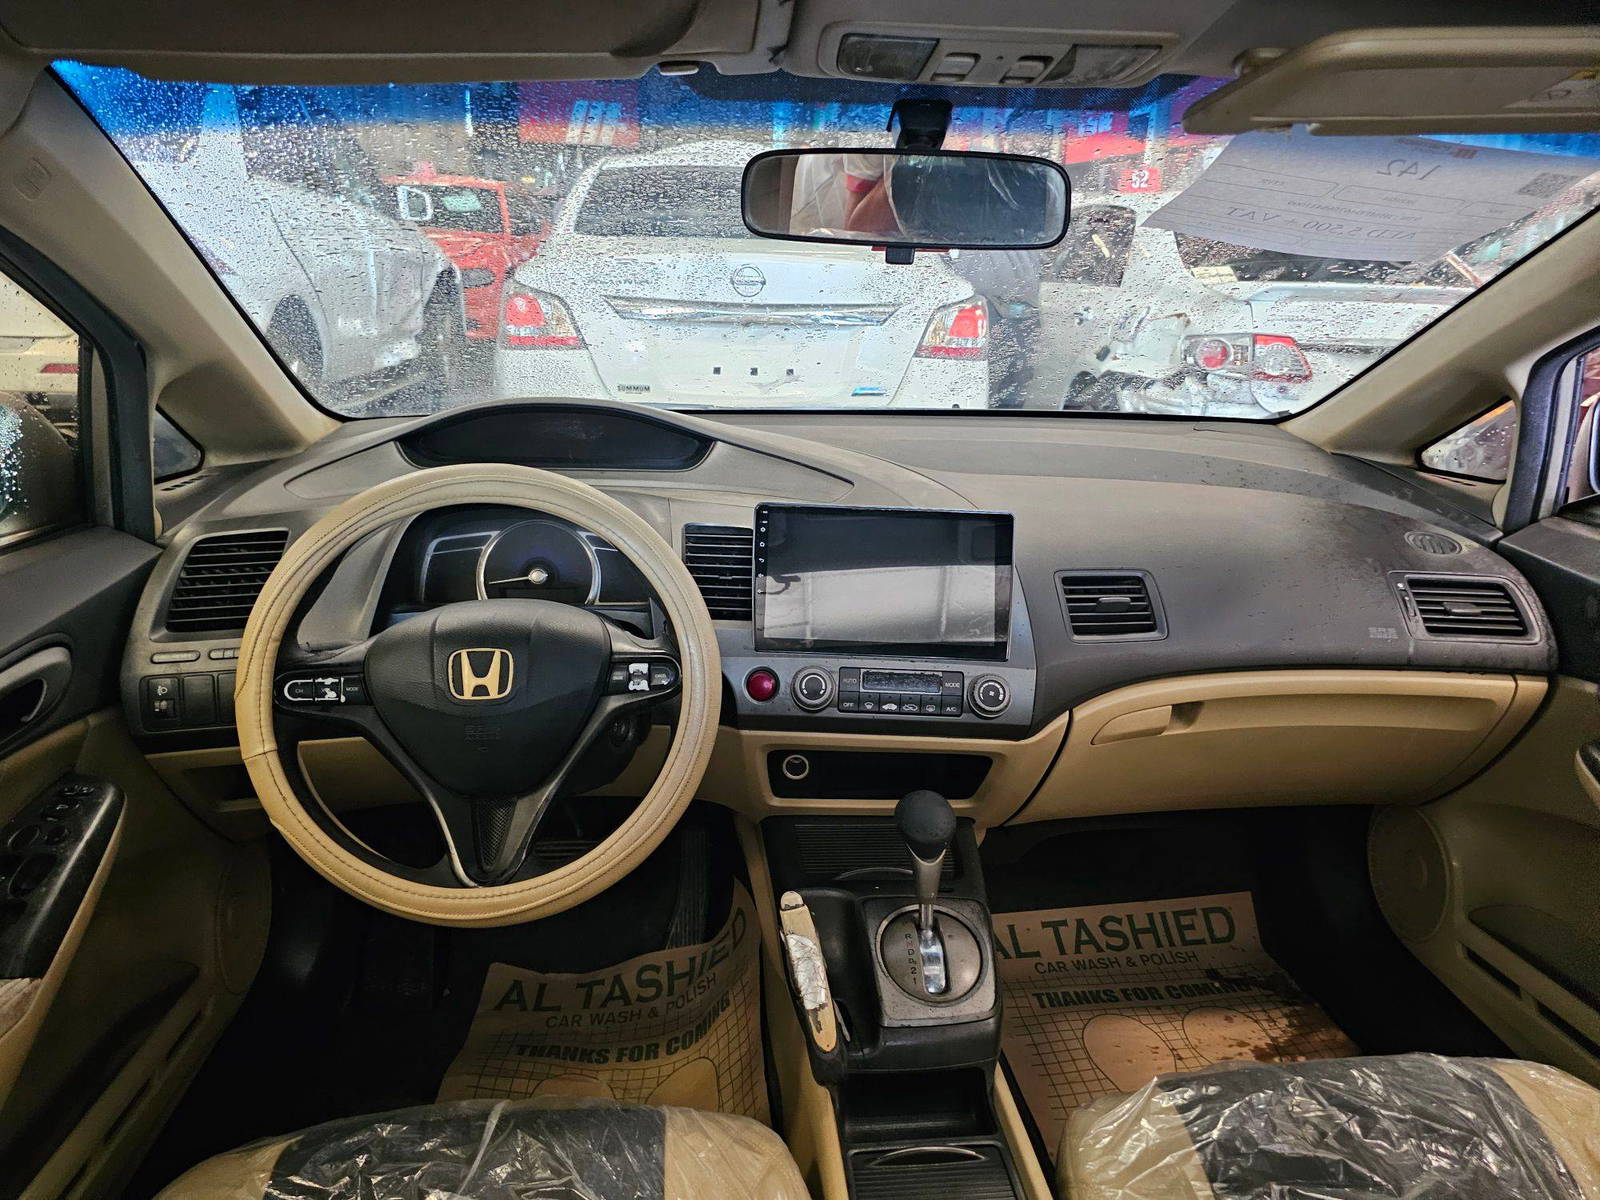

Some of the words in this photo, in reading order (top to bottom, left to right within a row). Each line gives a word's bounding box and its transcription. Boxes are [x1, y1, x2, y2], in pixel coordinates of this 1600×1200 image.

[1041, 906, 1236, 955] TASHIED
[493, 979, 562, 1012] AL
[576, 906, 747, 1010] TASHIED
[1034, 960, 1071, 975] CAR
[1072, 954, 1123, 971] WASH
[1126, 956, 1137, 968] &
[1141, 951, 1199, 967] POLISH
[545, 1013, 582, 1029] CAR
[589, 1007, 642, 1026] WASH
[647, 1005, 659, 1019] &
[665, 972, 717, 1016] POLISH
[1032, 988, 1119, 1009] THANKS
[1119, 985, 1167, 1004] FOR
[515, 1043, 609, 1065] THANKS
[614, 1042, 660, 1063] FOR
[664, 990, 731, 1056] COMING
